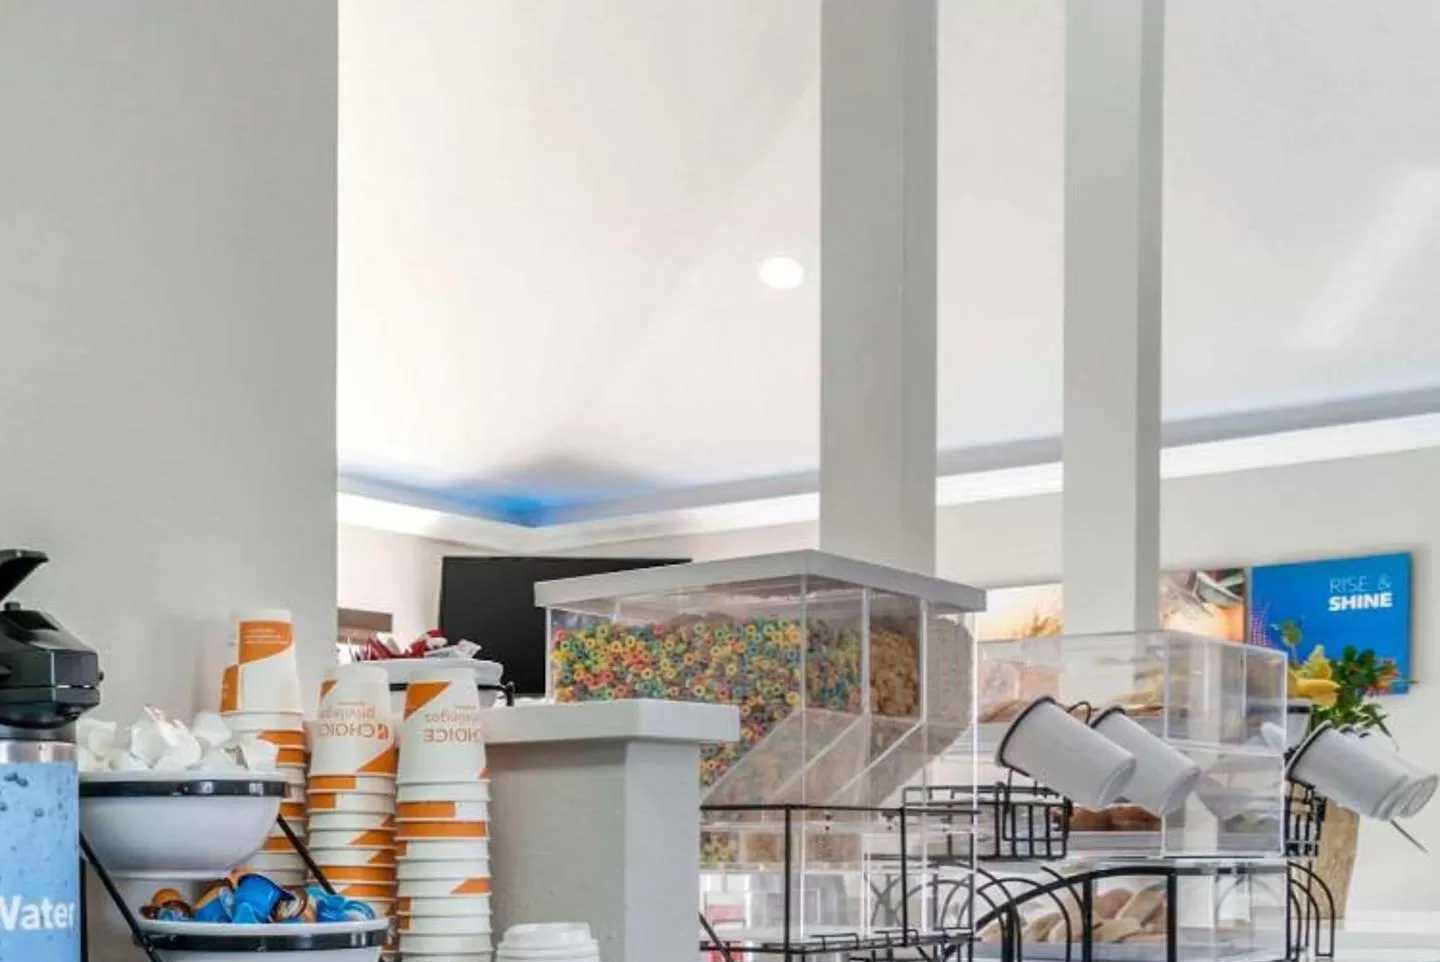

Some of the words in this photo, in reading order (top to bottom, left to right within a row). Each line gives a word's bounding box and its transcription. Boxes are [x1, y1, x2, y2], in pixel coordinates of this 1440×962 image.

[1329, 576, 1372, 593] RISE
[1377, 573, 1392, 591] &
[1328, 592, 1393, 612] SHINE
